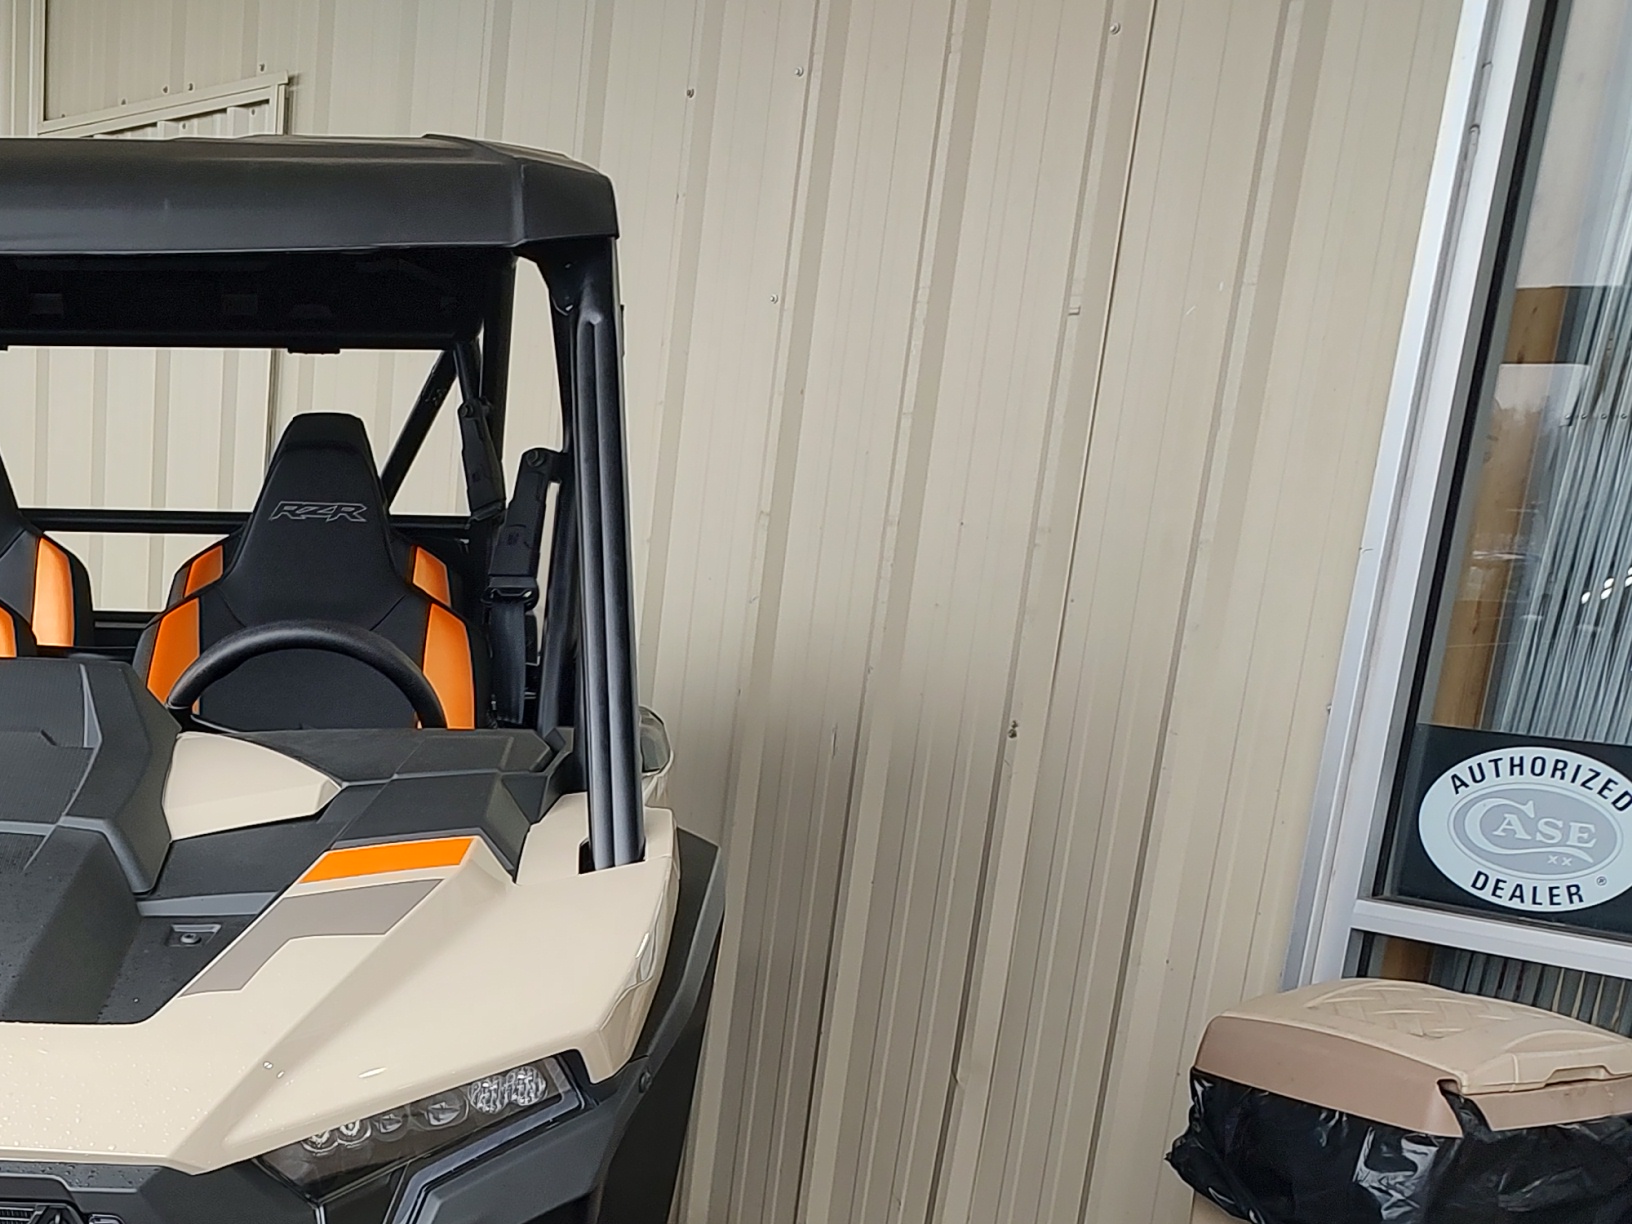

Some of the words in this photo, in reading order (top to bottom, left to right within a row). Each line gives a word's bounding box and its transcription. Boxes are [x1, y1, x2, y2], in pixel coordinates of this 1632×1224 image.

[269, 501, 367, 522] RZR
[1450, 756, 1632, 812] AUTHORIZED
[1464, 797, 1597, 863] CASE
[1470, 870, 1584, 906] DEALER
